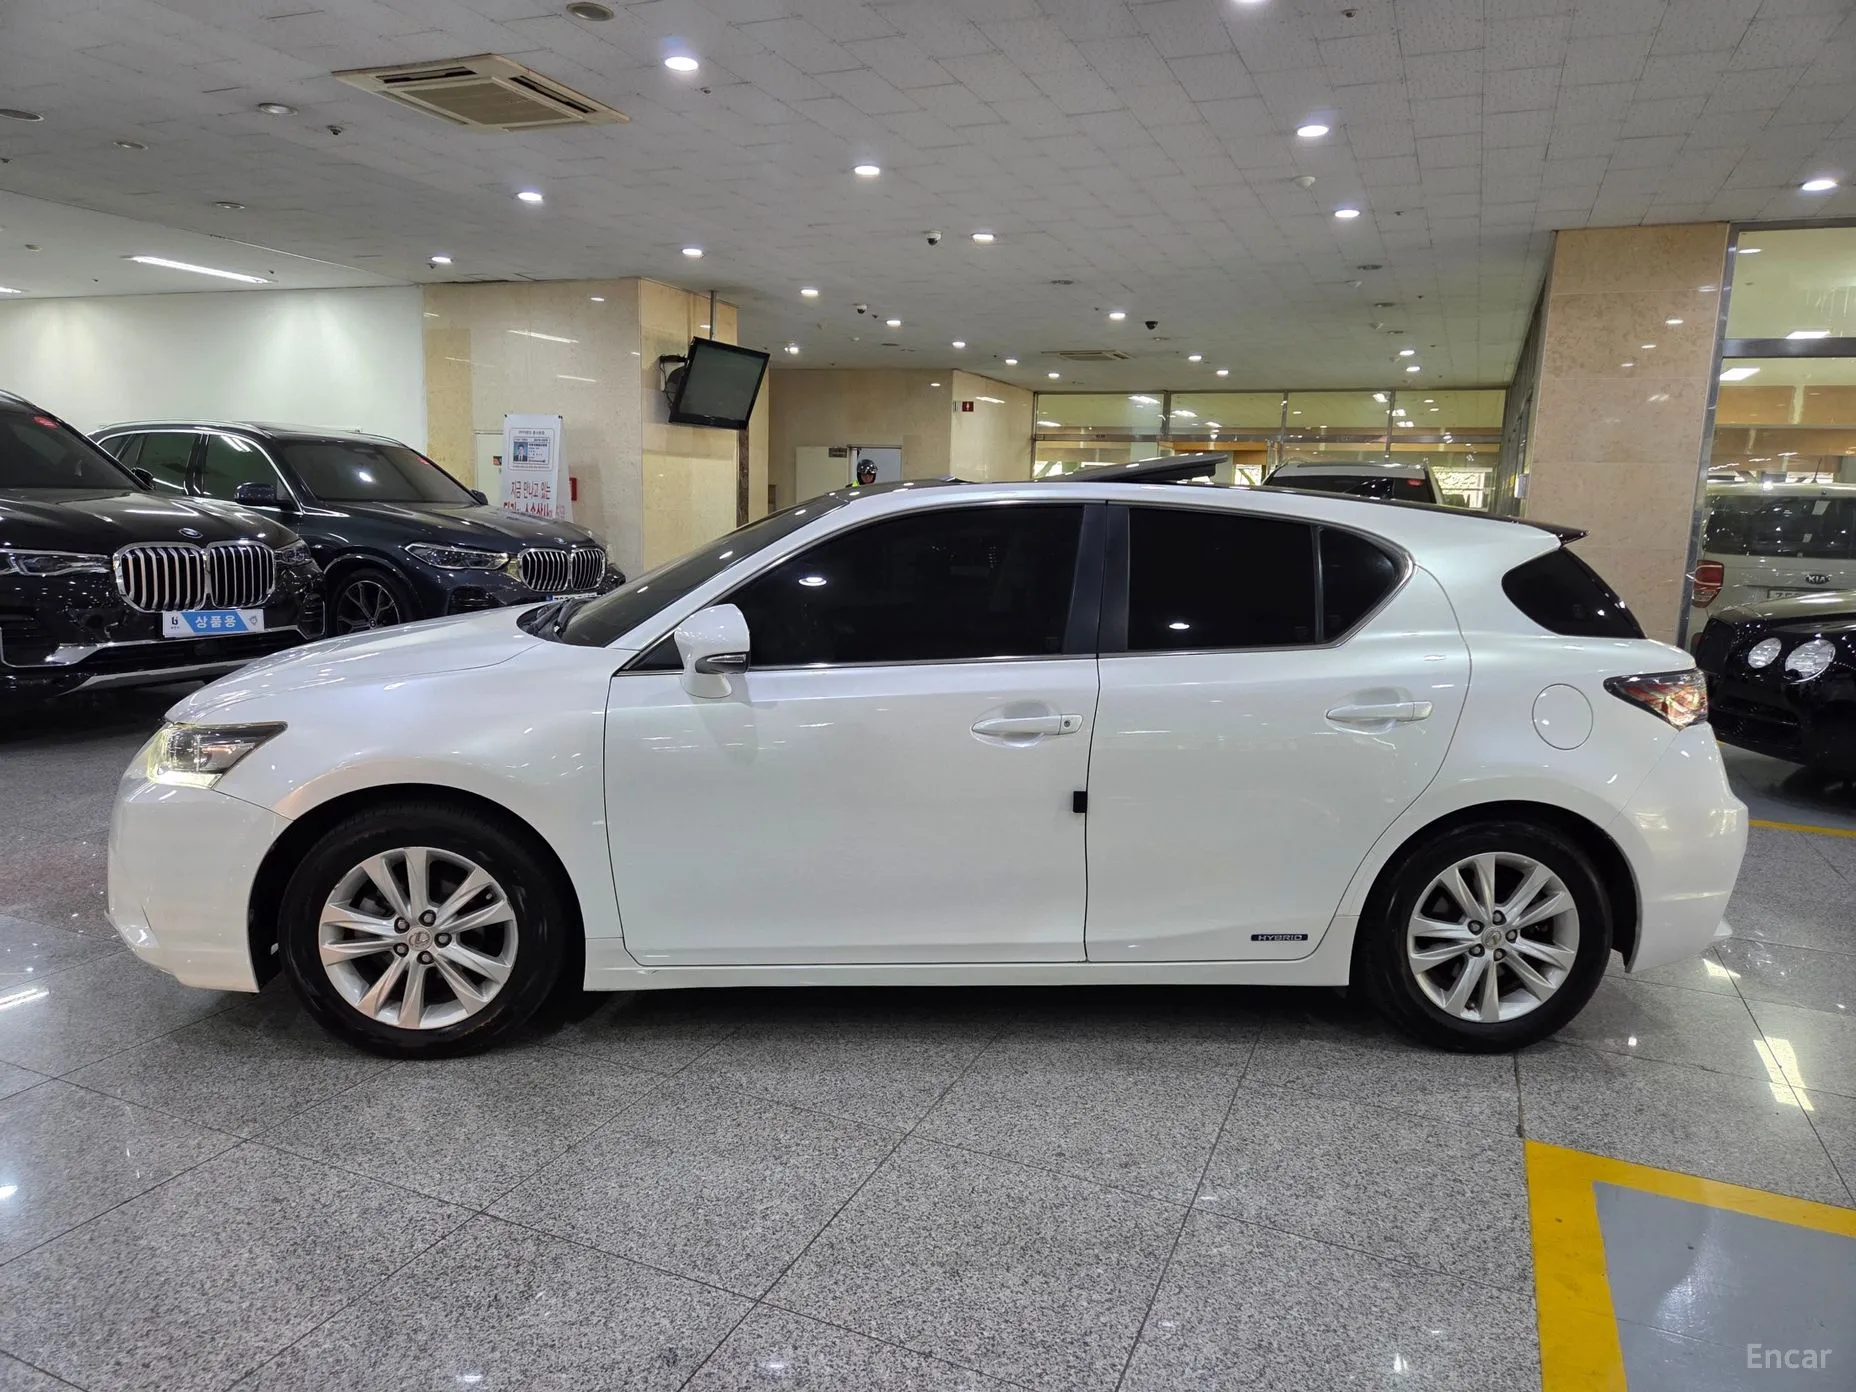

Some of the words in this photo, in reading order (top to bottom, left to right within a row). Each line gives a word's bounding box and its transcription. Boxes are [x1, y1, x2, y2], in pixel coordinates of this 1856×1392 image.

[511, 480, 521, 499] 지금
[524, 481, 538, 499] 만나고
[541, 481, 551, 500] 있는
[1808, 575, 1827, 583] KIA
[195, 615, 236, 629] 상품용
